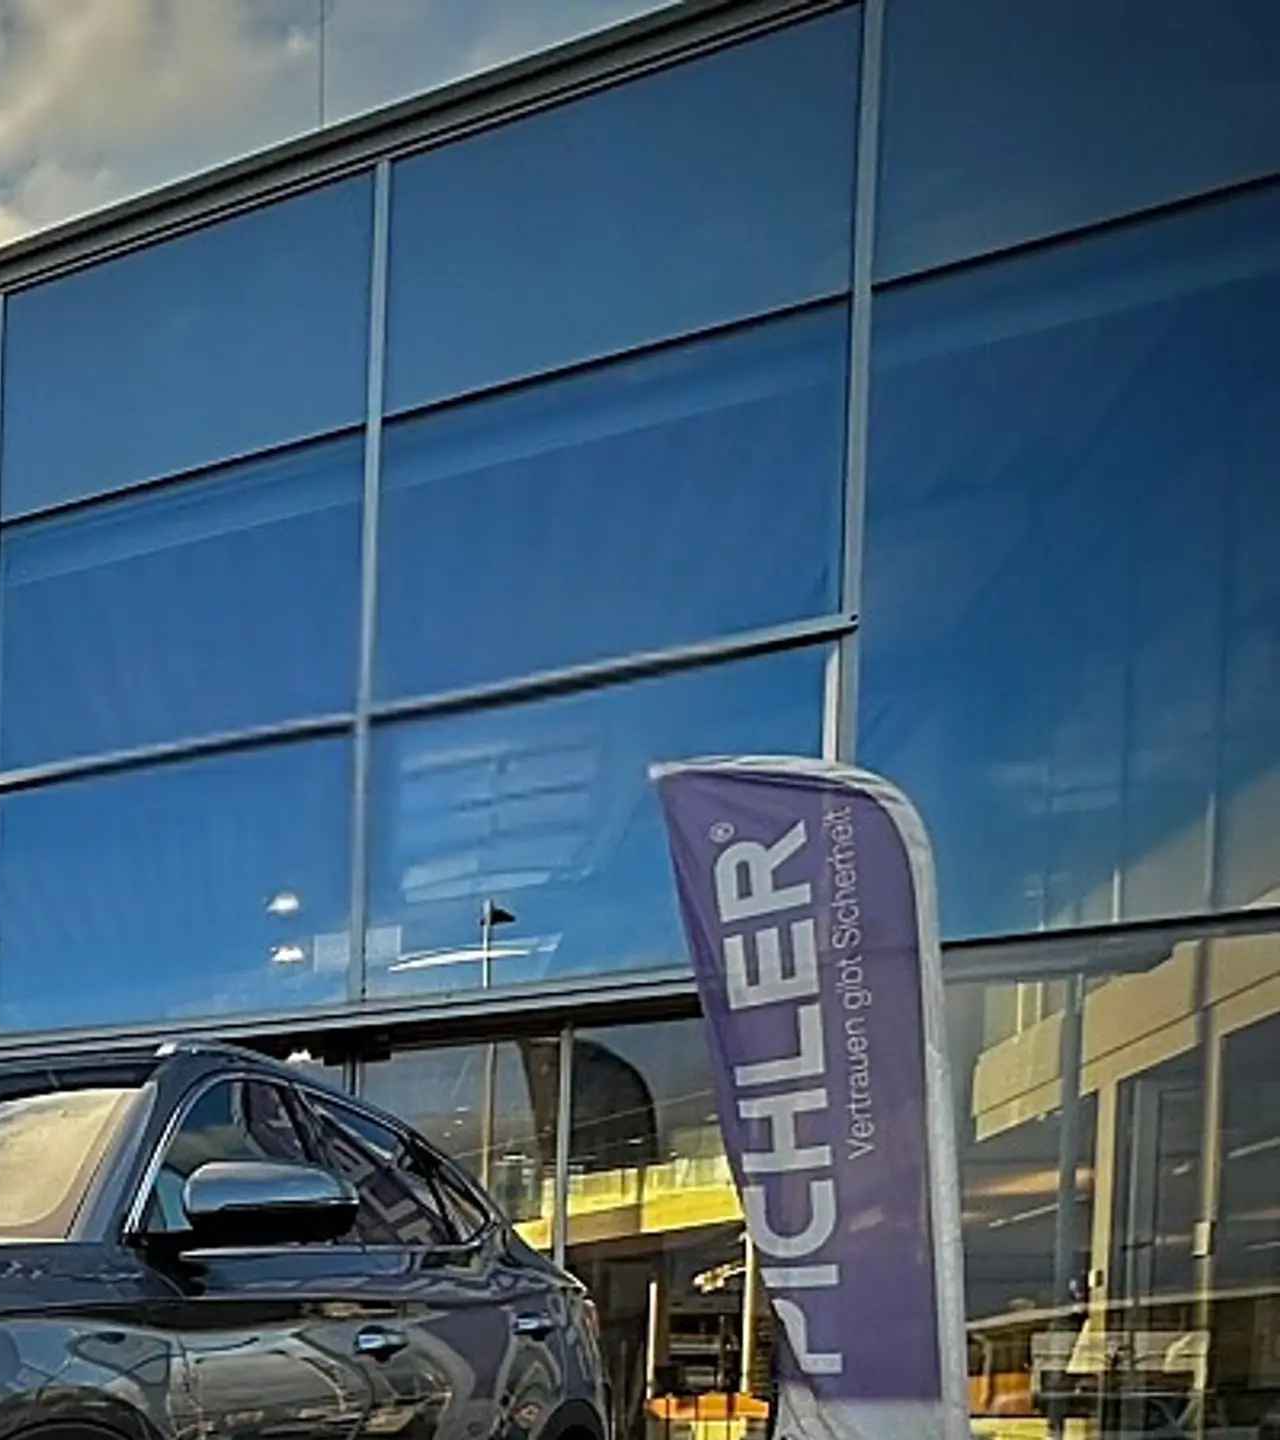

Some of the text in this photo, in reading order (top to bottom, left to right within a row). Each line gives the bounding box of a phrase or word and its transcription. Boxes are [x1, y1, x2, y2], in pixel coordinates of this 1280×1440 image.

[824, 806, 875, 1161] Vertrauen gibt Sicherheit
